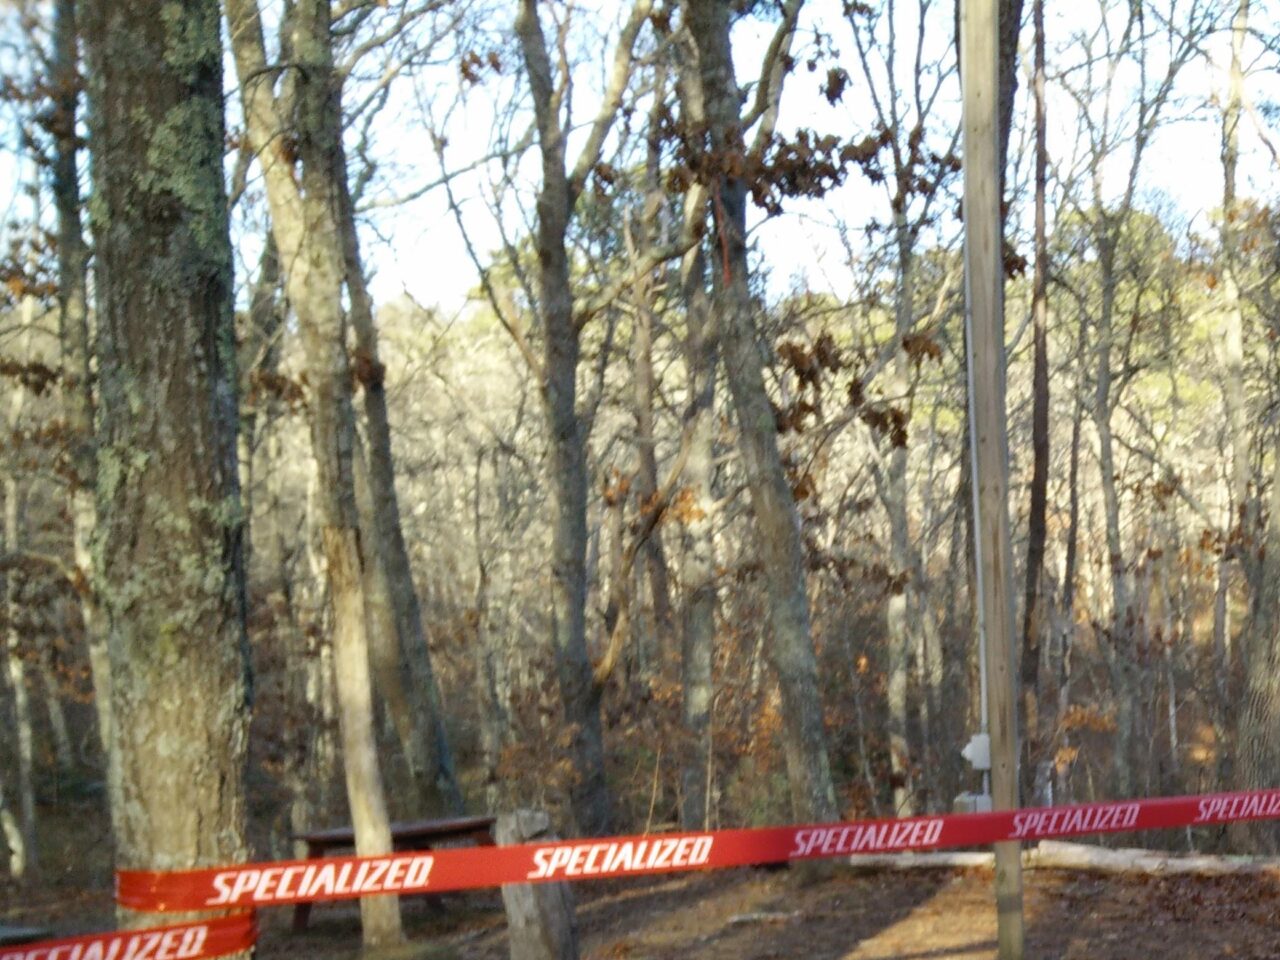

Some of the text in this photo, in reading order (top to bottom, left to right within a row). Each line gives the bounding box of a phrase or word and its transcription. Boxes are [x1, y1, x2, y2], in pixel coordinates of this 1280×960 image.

[789, 818, 943, 857] SPECIALIZED
[1009, 803, 1139, 836] SPECIALIZED
[527, 836, 714, 879] SPECIALIZED
[205, 856, 433, 905] SPECIALIZED
